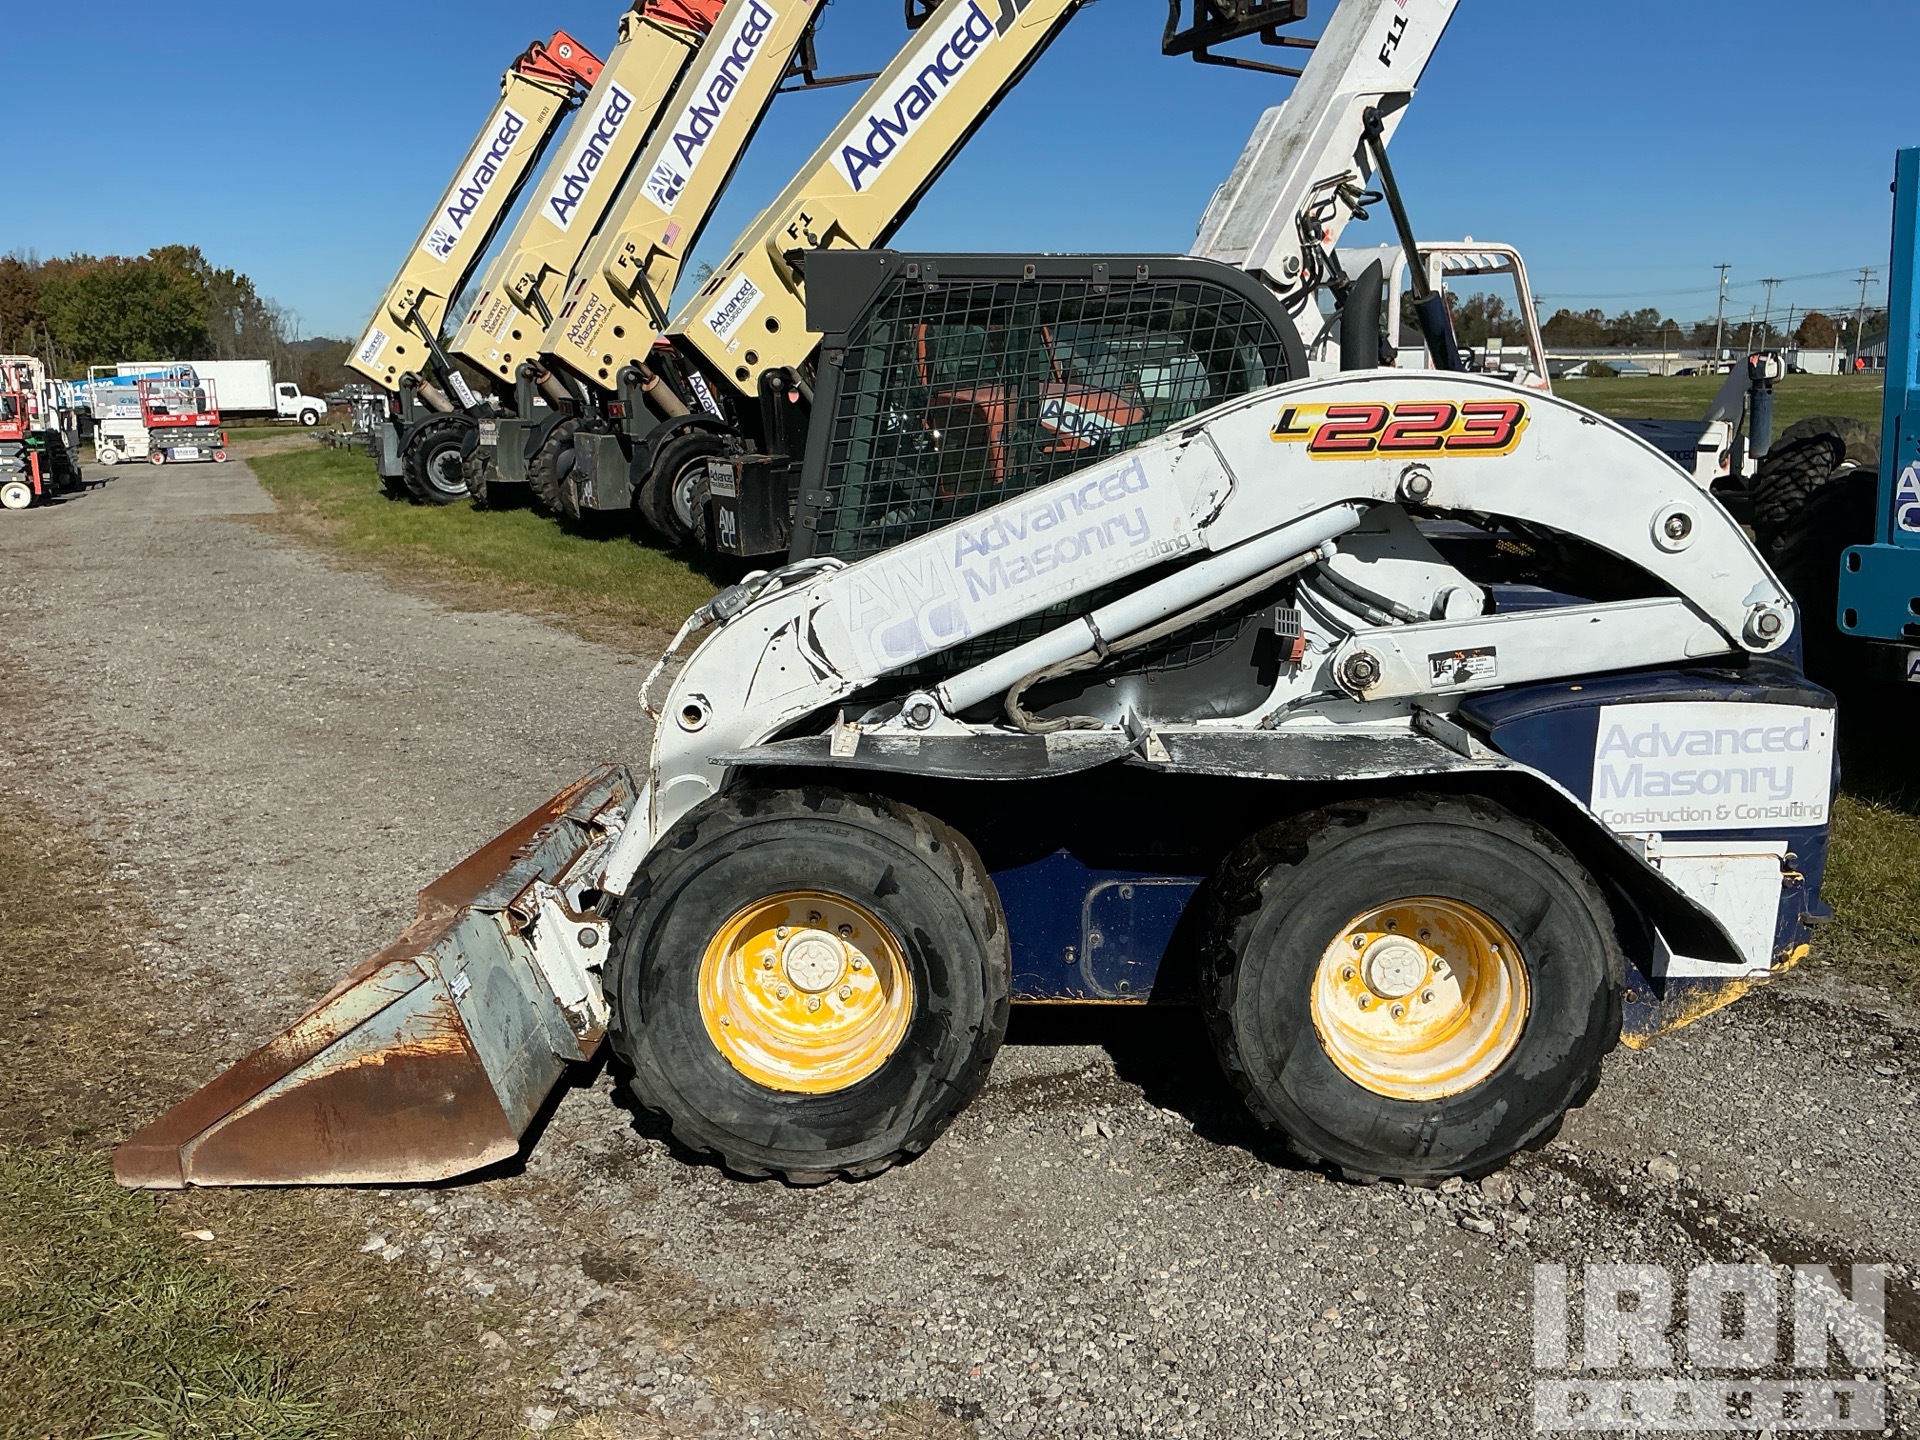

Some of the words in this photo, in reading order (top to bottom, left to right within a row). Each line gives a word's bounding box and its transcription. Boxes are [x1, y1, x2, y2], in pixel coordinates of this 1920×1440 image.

[1378, 14, 1409, 68] F11
[673, 0, 773, 168] Advanced
[841, 0, 994, 192] Advanced
[447, 110, 525, 231] Advanced
[550, 86, 632, 226] Advanced
[480, 297, 502, 331] Advanced
[567, 292, 600, 343] Advanced
[573, 303, 608, 349] Masonry
[709, 278, 755, 334] Advanced
[361, 330, 383, 362] Advanced
[1271, 399, 1530, 461] L223
[710, 469, 734, 484] Advanced
[955, 456, 1150, 569] Advanced
[961, 507, 1151, 603] Masonry
[1102, 533, 1192, 575] Consulting
[1597, 716, 1812, 760] Advanced
[1600, 763, 1794, 801] Masonry
[1600, 806, 1712, 825] Construction
[1715, 804, 1732, 820] &
[1734, 801, 1824, 820] Consulting
